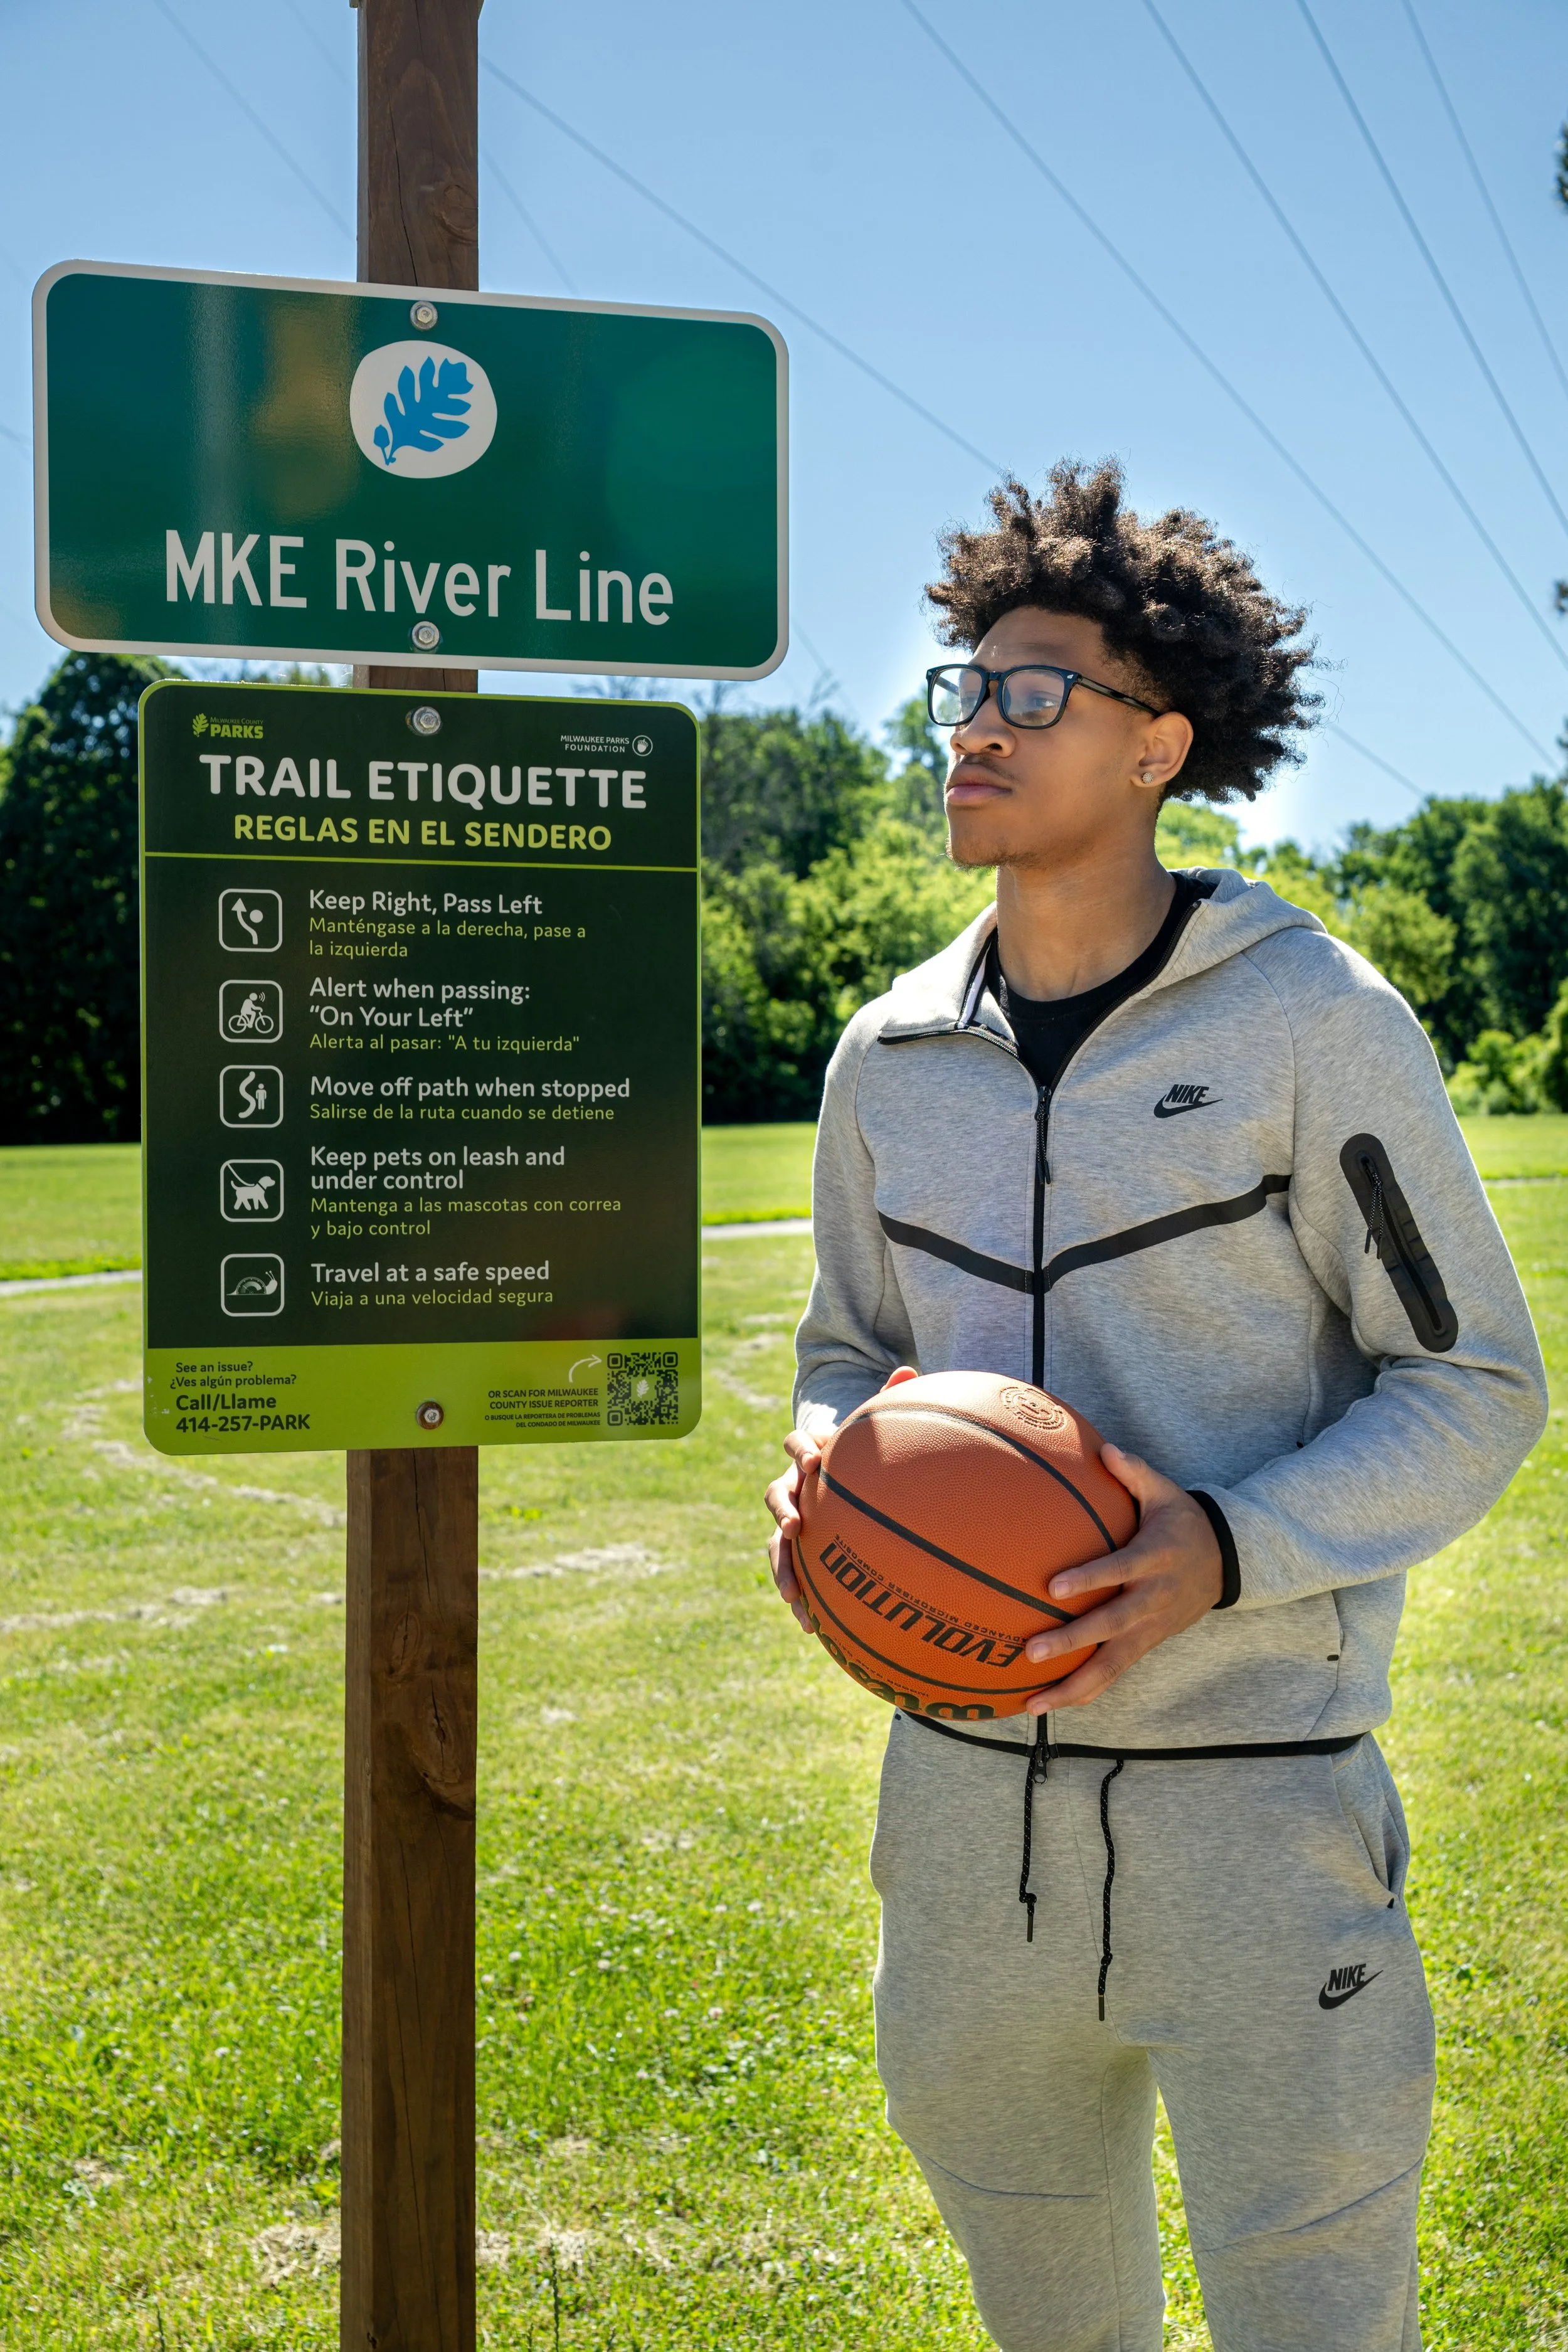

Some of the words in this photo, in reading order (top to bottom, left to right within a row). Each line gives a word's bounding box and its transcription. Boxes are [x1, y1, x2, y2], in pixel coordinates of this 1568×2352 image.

[166, 530, 307, 608] MKE
[336, 539, 511, 617] River
[536, 549, 673, 625] Line
[211, 724, 263, 738] PARKS
[561, 735, 604, 743] MILWAUKEE
[565, 744, 625, 753] FOUNDATION
[199, 755, 351, 798] TRAIL
[369, 761, 646, 810] ETIQUETTE
[235, 815, 358, 842] REGLAS
[369, 819, 409, 844] EN
[421, 821, 455, 845] EL
[465, 822, 611, 850] SENDERO
[310, 889, 365, 915] Keep
[373, 891, 437, 916] Right,
[444, 893, 491, 913] Pass
[499, 894, 542, 914] Left
[310, 918, 415, 937] Manténgase
[422, 924, 430, 934] a
[438, 920, 450, 935] la
[457, 921, 527, 938] derecha,
[534, 926, 571, 940] pase
[578, 928, 585, 938] a
[310, 940, 322, 955] la
[331, 941, 407, 960] izquierda
[310, 977, 366, 997] Alert
[373, 978, 433, 998] when
[442, 980, 529, 1005] passing:
[310, 1034, 363, 1049] Alerta
[370, 1034, 383, 1049] al
[391, 1037, 441, 1053] pasar:
[449, 1035, 467, 1049] "A
[473, 1037, 490, 1050] tu
[497, 1036, 579, 1054] izquierda"
[311, 1076, 373, 1096] Move
[381, 1077, 413, 1096] off
[419, 1077, 468, 1101] path
[475, 1077, 534, 1096] when
[542, 1078, 629, 1102] stopped
[1165, 1084, 1209, 1104] NIKE
[310, 1103, 366, 1118] Salirse
[373, 1104, 393, 1118] de
[401, 1104, 413, 1119] la
[421, 1106, 454, 1119] ruta
[462, 1104, 522, 1119] cuando
[529, 1110, 546, 1119] se
[552, 1104, 614, 1120] detiene
[312, 1147, 366, 1172] Keep
[374, 1148, 421, 1170] pets
[429, 1152, 455, 1165] on
[464, 1146, 518, 1165] leash
[526, 1146, 564, 1165] and
[312, 1170, 377, 1189] under
[384, 1169, 463, 1189] control
[312, 1198, 397, 1216] Mantenga
[405, 1202, 412, 1212] a
[420, 1197, 442, 1212] las
[448, 1199, 527, 1211] mascotas
[534, 1201, 563, 1211] con
[569, 1201, 620, 1210] correa
[311, 1223, 320, 1239] y
[327, 1221, 363, 1239] bajo
[369, 1220, 430, 1235] control
[311, 1263, 378, 1282] Travel
[386, 1264, 409, 1281] at
[416, 1266, 426, 1281] a
[434, 1262, 479, 1281] safe
[486, 1260, 549, 1285] speed
[311, 1291, 352, 1309] Viaja
[360, 1295, 368, 1305] a
[376, 1295, 405, 1305] una
[412, 1288, 491, 1304] velocidad
[499, 1290, 553, 1306] segura
[176, 1362, 197, 1373] See
[218, 1361, 253, 1372] issue?
[170, 1377, 196, 1389] ¿Ves
[200, 1375, 231, 1389] algún
[236, 1374, 297, 1388] problema?
[176, 1393, 276, 1411] Call/Llame
[548, 1388, 598, 1396] MILWAUKEE
[490, 1401, 527, 1409] COUNTY
[529, 1400, 553, 1408] ISSUE
[554, 1399, 598, 1407] REPORTER
[176, 1414, 310, 1433] 414-257-PARK
[834, 1533, 884, 1581] COMPOSITE
[819, 1542, 1024, 1668] EVOLUTION
[887, 1582, 958, 1623] MICROFIBER
[964, 1621, 1028, 1642] ADVANCED
[1327, 1963, 1366, 1991] NIKE
